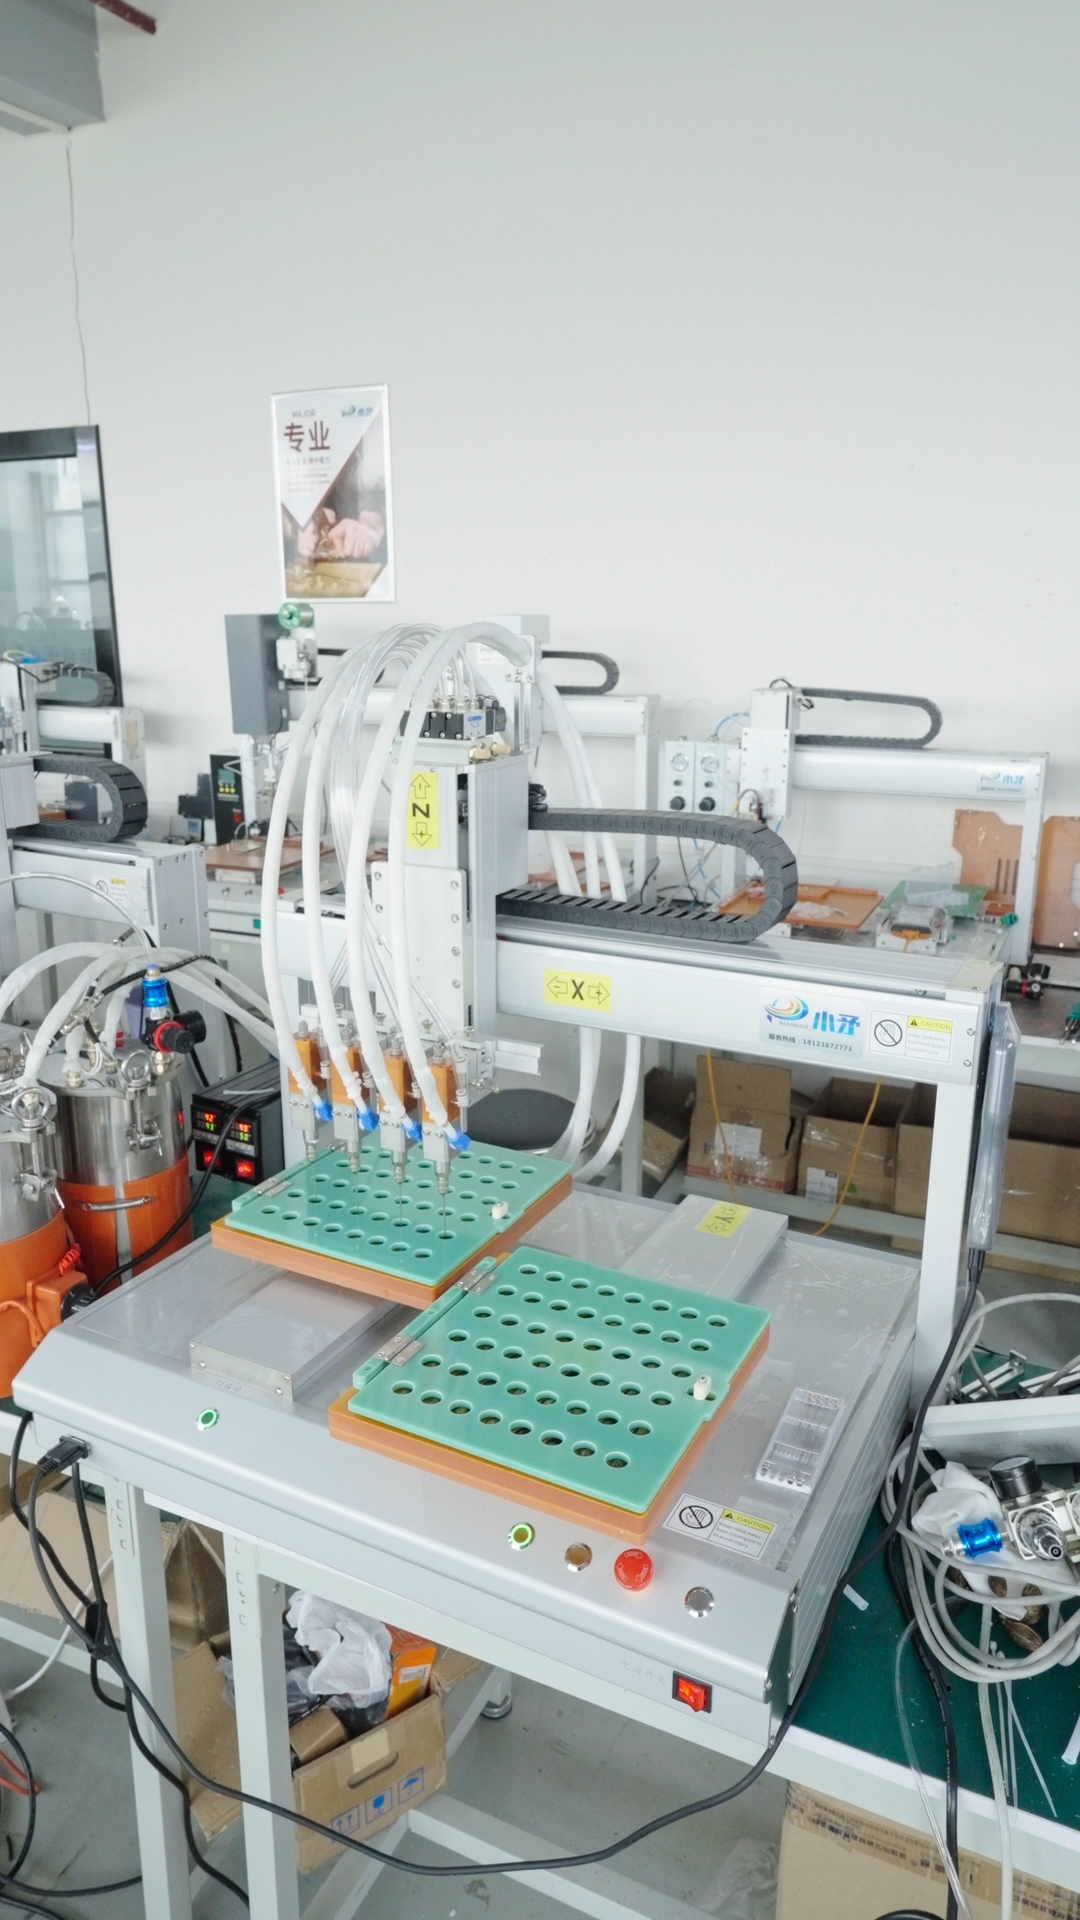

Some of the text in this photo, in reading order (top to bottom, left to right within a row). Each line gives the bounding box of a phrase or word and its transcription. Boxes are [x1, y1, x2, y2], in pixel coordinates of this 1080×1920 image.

[292, 409, 316, 418] MAJOR
[284, 420, 331, 453] 专业
[571, 979, 585, 1001] X
[920, 1020, 951, 1030] CAUTION
[719, 1522, 761, 1539] Keep hand away
[736, 1516, 771, 1532] CAUTION
[716, 1527, 762, 1546] from moving parts
